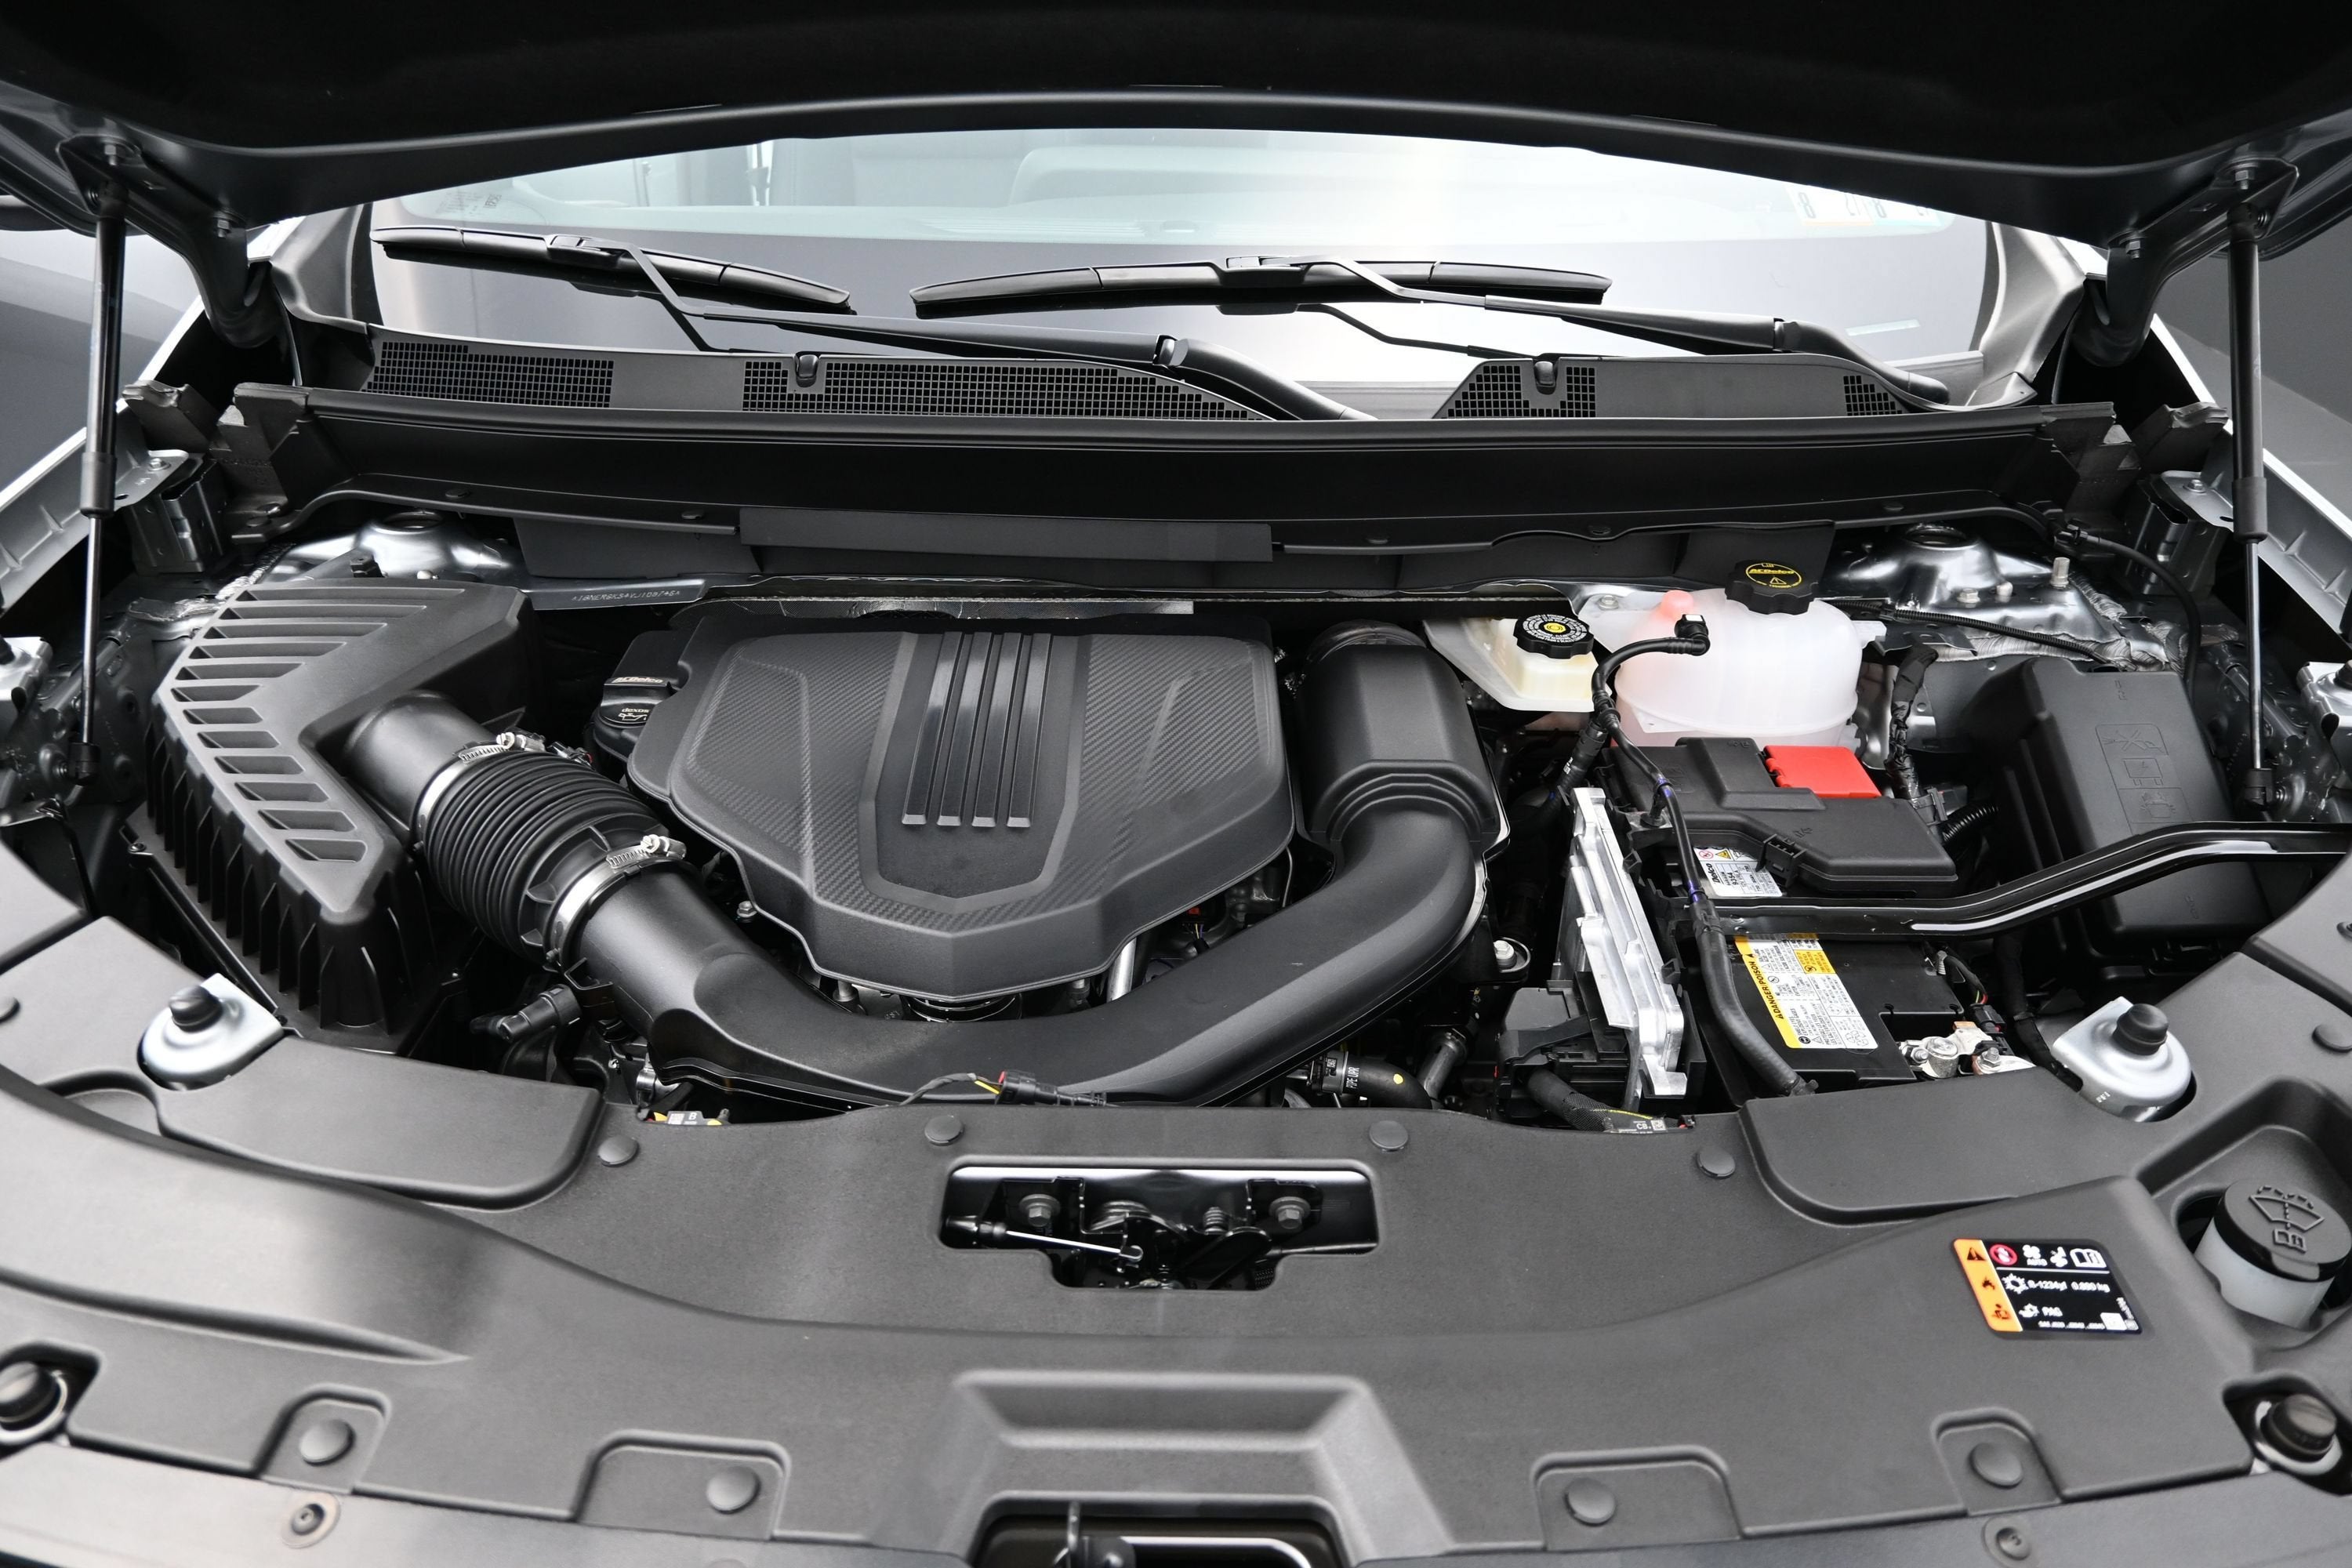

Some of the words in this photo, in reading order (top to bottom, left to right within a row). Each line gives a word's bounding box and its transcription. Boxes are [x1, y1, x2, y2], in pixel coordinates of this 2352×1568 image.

[1748, 961, 1781, 1014] DANGER/POISON
[1348, 1066, 1360, 1078] UPR
[1345, 1076, 1358, 1088] PIPE
[688, 1112, 697, 1120] B
